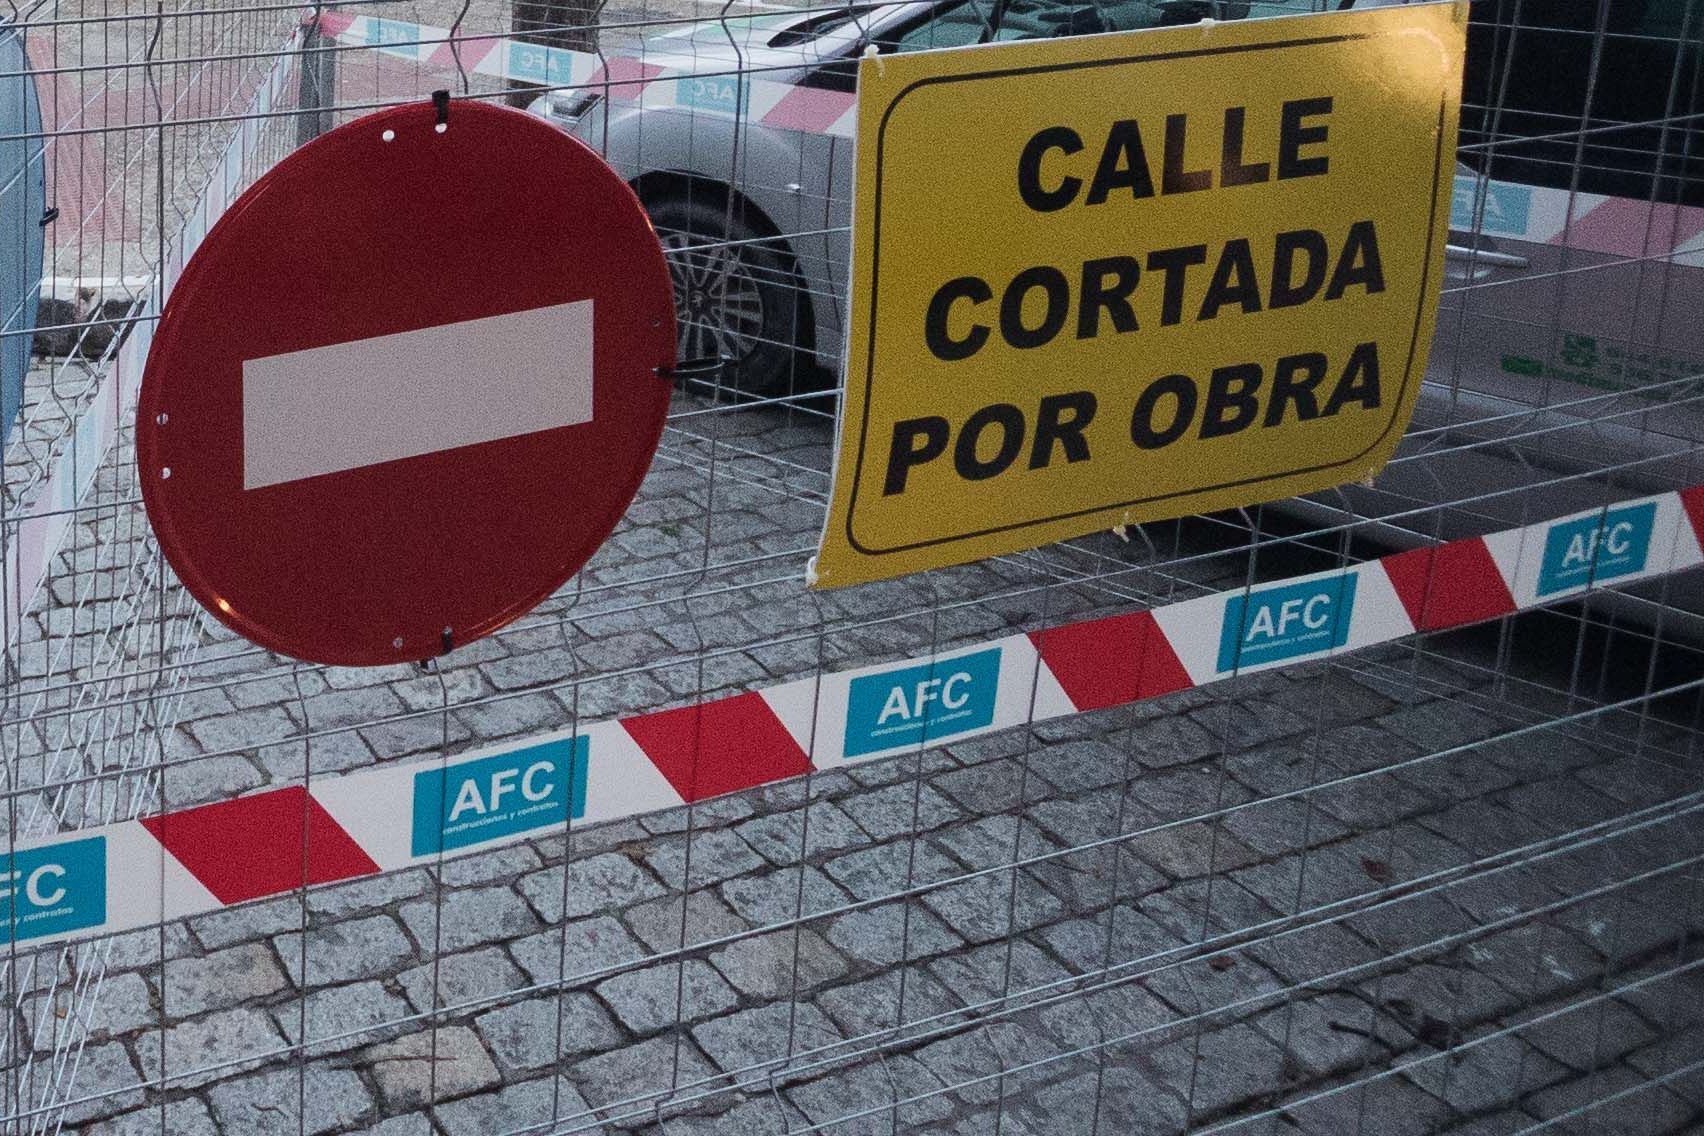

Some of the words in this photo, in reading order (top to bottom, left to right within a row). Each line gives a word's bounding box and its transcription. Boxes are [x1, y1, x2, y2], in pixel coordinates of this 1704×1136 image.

[1017, 96, 1333, 213] CALLE
[925, 220, 1386, 361] CORTADA
[882, 390, 1097, 497] POR
[1130, 341, 1381, 450] OBRA
[1561, 522, 1632, 567] AFC
[1245, 594, 1330, 642] AFC
[877, 672, 972, 725] AFC
[448, 761, 555, 821] AFC
